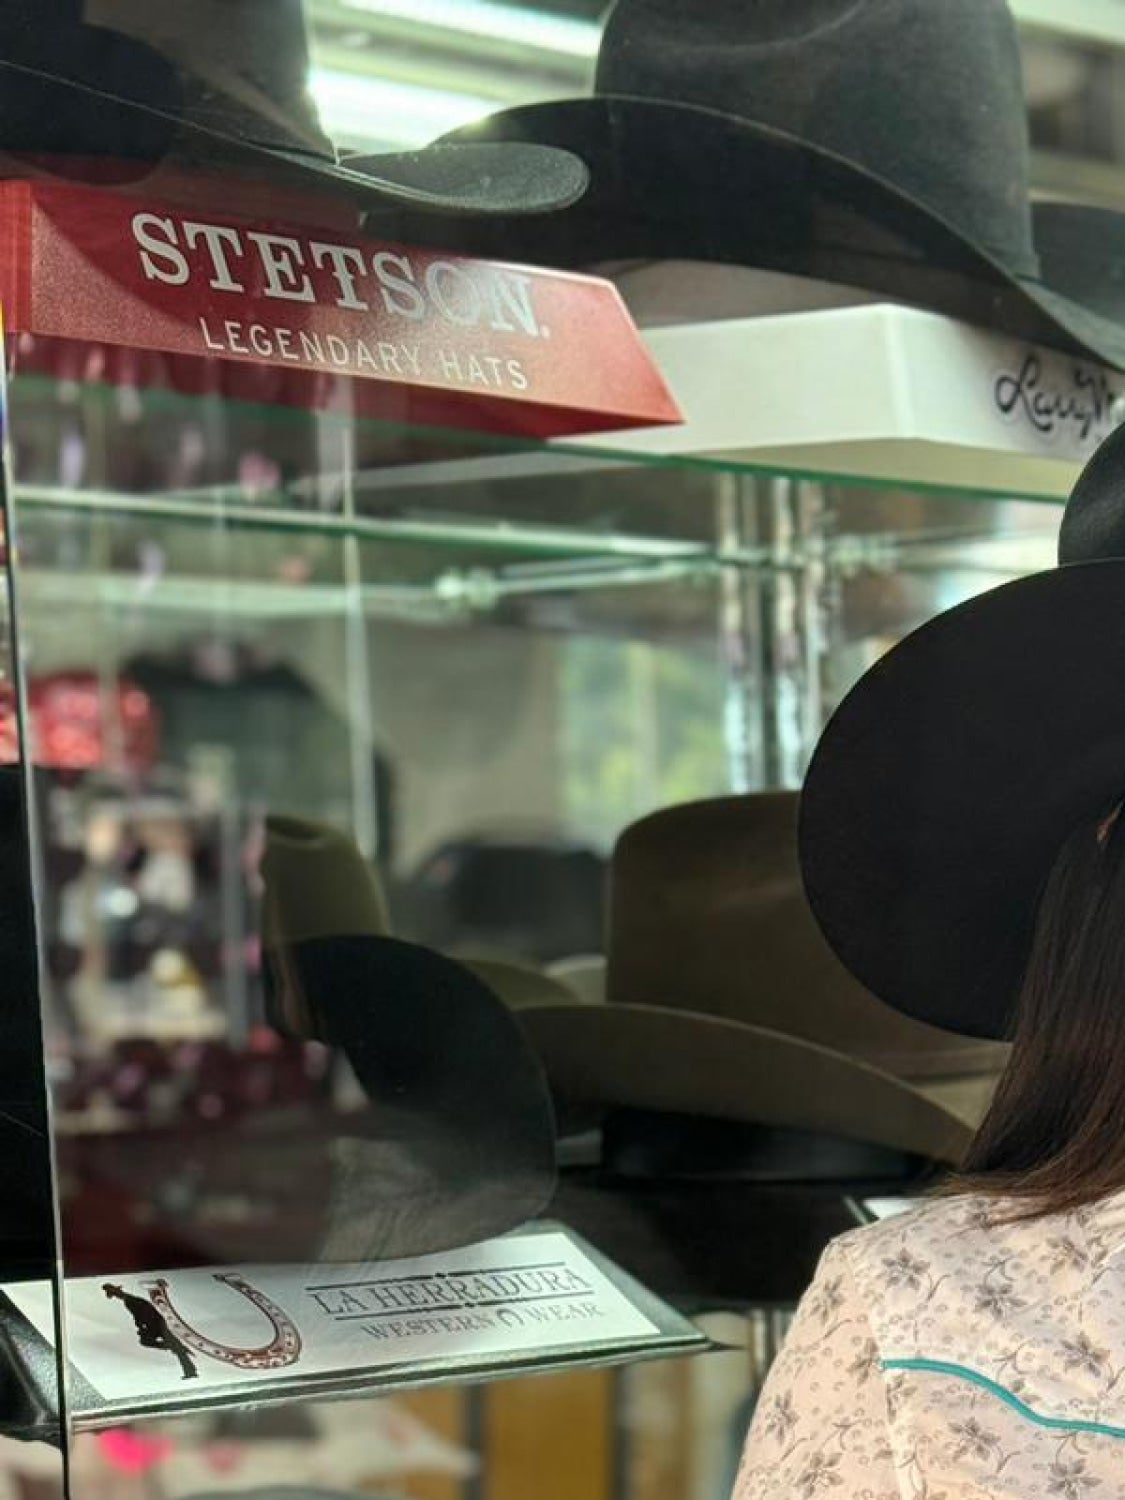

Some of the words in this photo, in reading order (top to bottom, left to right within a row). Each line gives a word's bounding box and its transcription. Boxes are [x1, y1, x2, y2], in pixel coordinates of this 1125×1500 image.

[200, 317, 420, 378] LEGENDARY
[440, 350, 528, 391] HATS
[312, 1289, 370, 1315] LA
[366, 1268, 591, 1309] HERRADURA
[360, 1314, 497, 1340] WESTERN
[525, 1302, 605, 1323] WEAR
